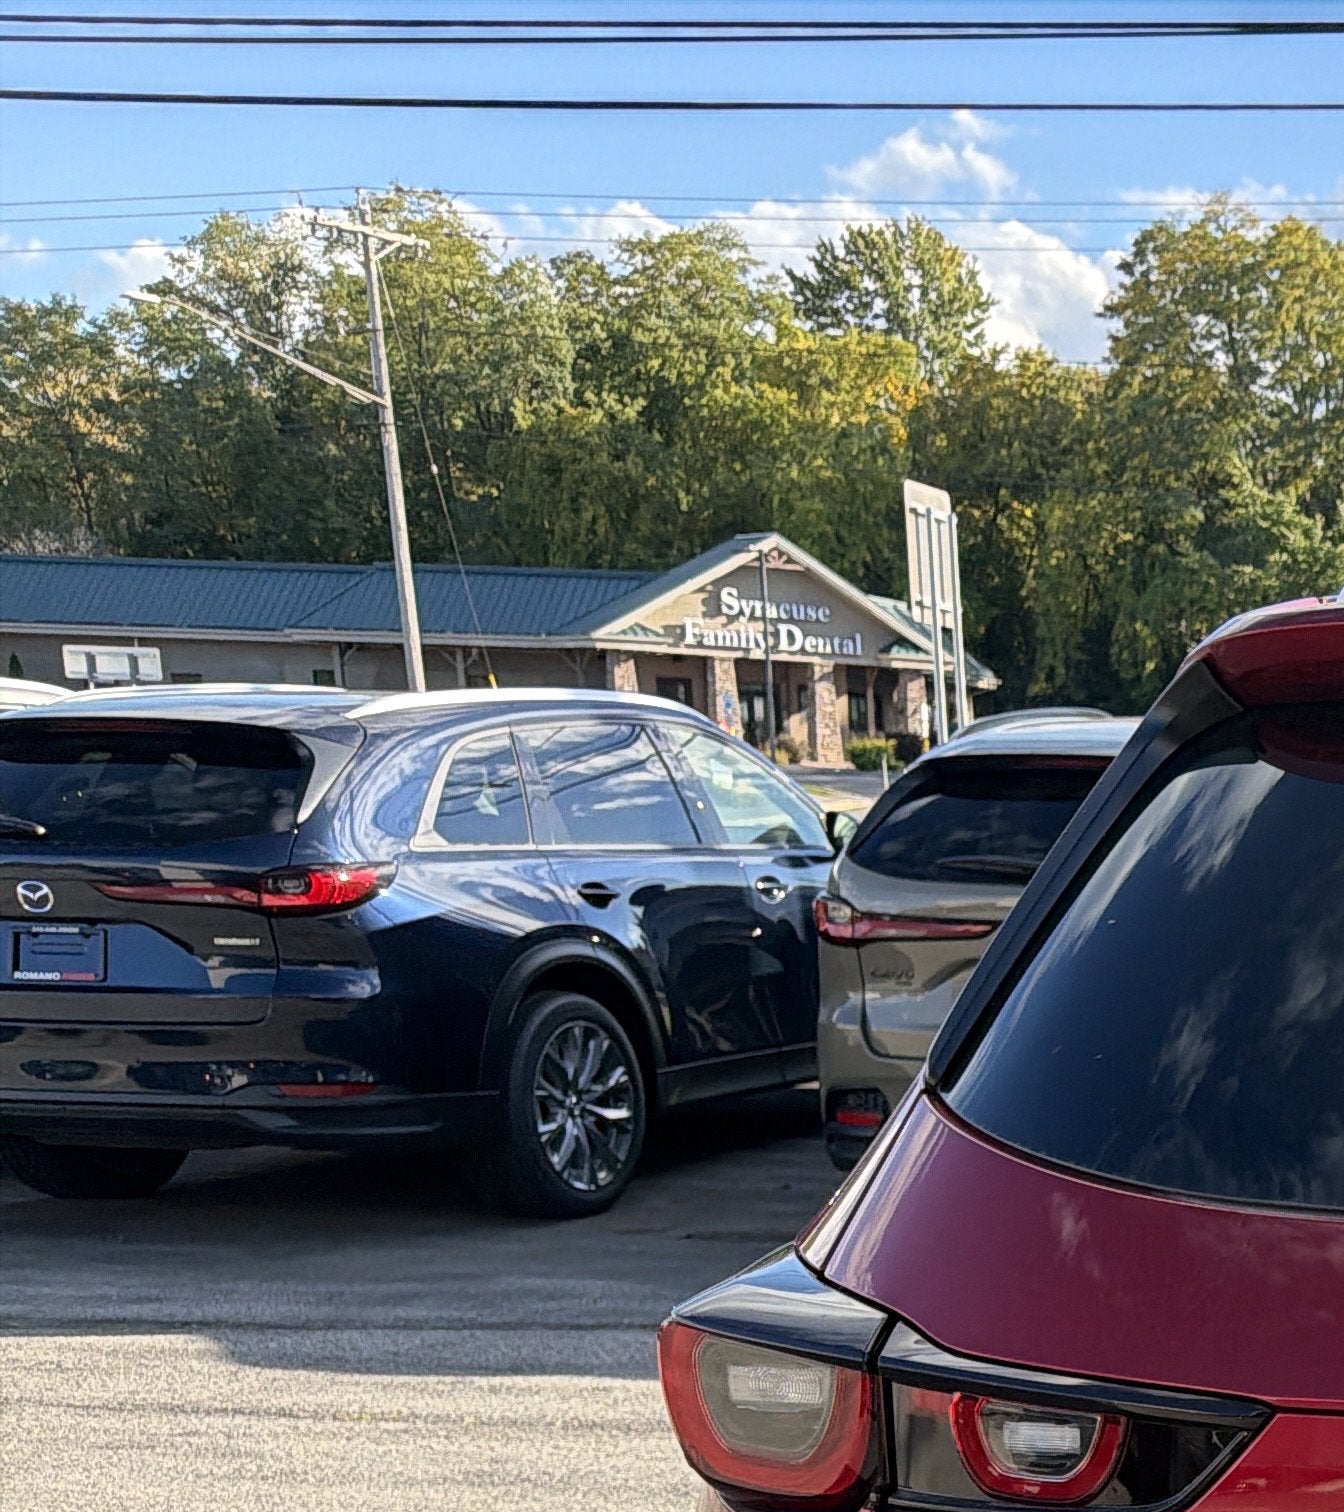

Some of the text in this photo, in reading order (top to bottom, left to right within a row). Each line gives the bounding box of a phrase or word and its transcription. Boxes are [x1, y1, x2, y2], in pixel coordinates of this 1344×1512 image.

[720, 586, 831, 622] Syracuse
[682, 617, 863, 655] Family Dental
